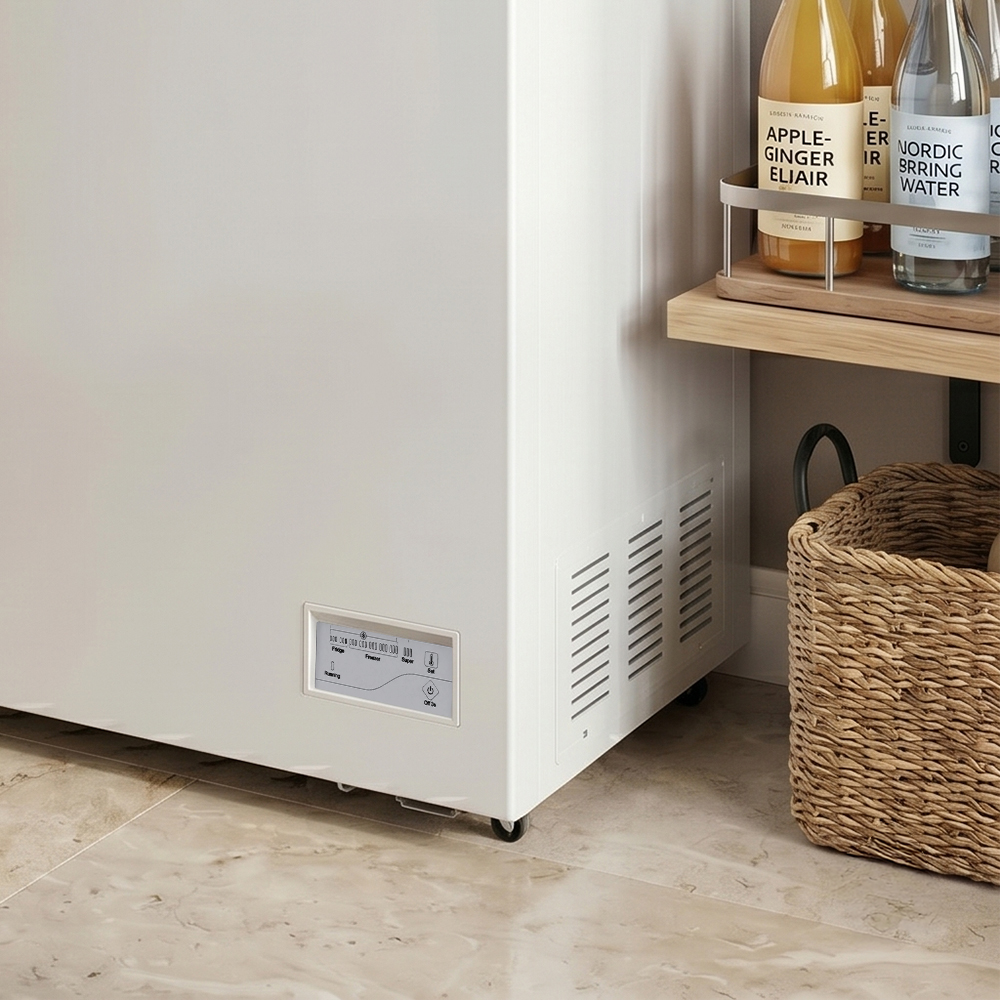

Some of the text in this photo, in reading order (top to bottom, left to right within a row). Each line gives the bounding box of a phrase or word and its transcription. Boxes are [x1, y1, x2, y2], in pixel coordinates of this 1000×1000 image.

[766, 126, 832, 146] APPLE-
[764, 146, 834, 166] GINGER
[897, 139, 963, 160] NORDIC
[900, 176, 960, 197] WATER
